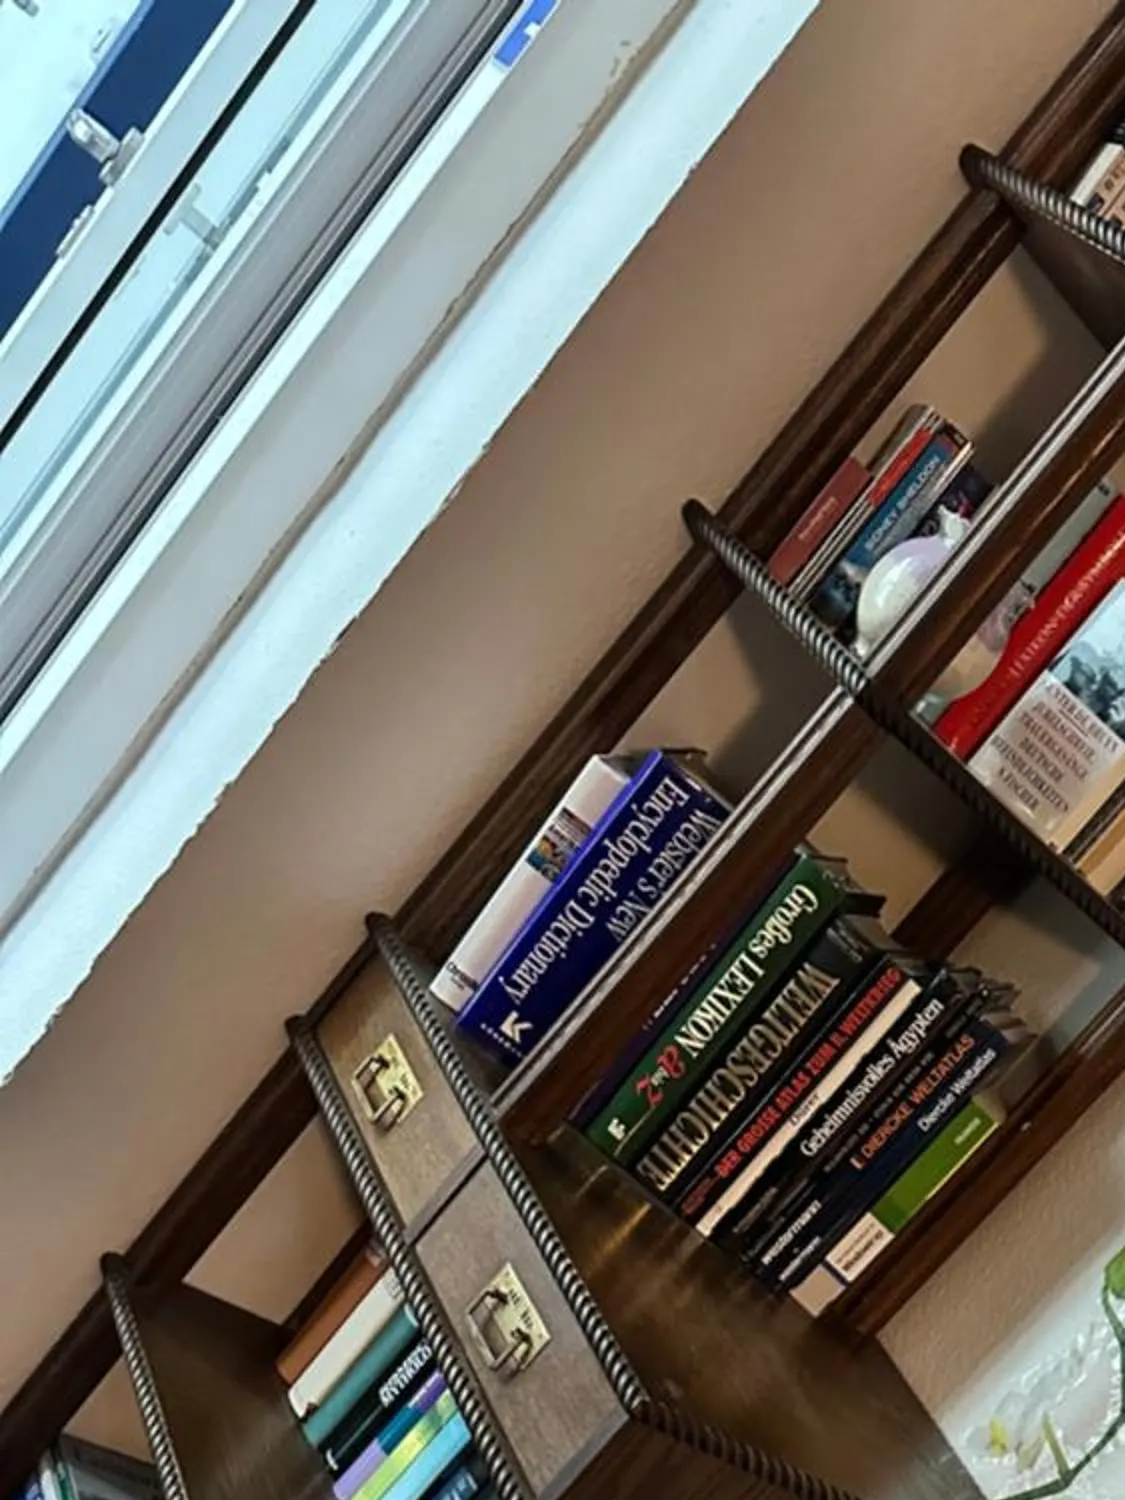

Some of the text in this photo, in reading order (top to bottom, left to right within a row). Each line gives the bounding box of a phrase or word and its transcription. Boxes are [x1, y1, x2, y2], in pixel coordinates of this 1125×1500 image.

[895, 454, 942, 510] SHELDON
[575, 775, 689, 907] Encyclopedic
[634, 805, 721, 900] Webster's
[497, 897, 593, 1006] Dictionary
[601, 889, 650, 943] New
[746, 883, 821, 960] Großes
[671, 950, 765, 1058] LEXIKON
[634, 962, 840, 1191] WELTGESCHICHTE
[713, 1145, 744, 1180] DER
[772, 1069, 812, 1112] ATLAS
[803, 1040, 838, 1076] ZUM
[837, 964, 902, 1037] WELTKRIEG
[798, 1050, 897, 1155] Geheimnisvolles
[887, 996, 946, 1060] Ägypten
[858, 1098, 914, 1159] DIERCKE
[906, 1032, 976, 1105] WELTATLAS
[915, 1088, 958, 1133] Diercke
